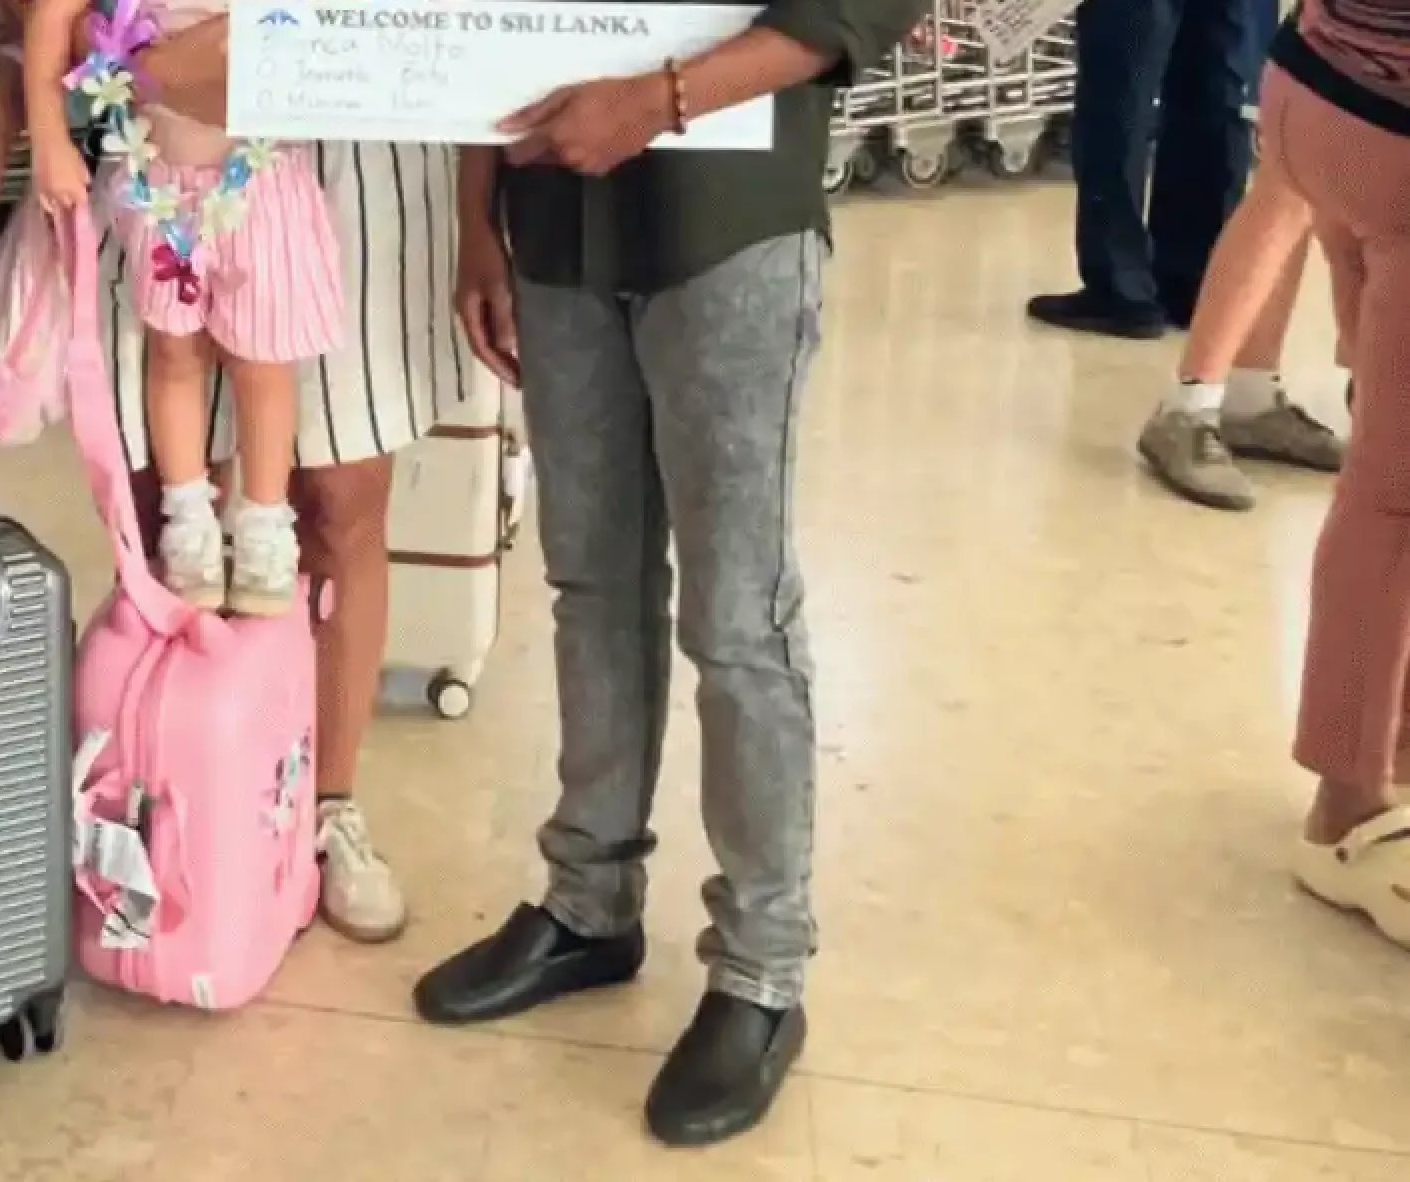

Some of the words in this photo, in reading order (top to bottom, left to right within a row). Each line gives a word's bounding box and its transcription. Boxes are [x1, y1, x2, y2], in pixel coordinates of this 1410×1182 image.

[315, 7, 453, 32] WELCOME
[458, 11, 494, 32] TO
[501, 13, 547, 35] SRI
[552, 14, 652, 37] LANKA
